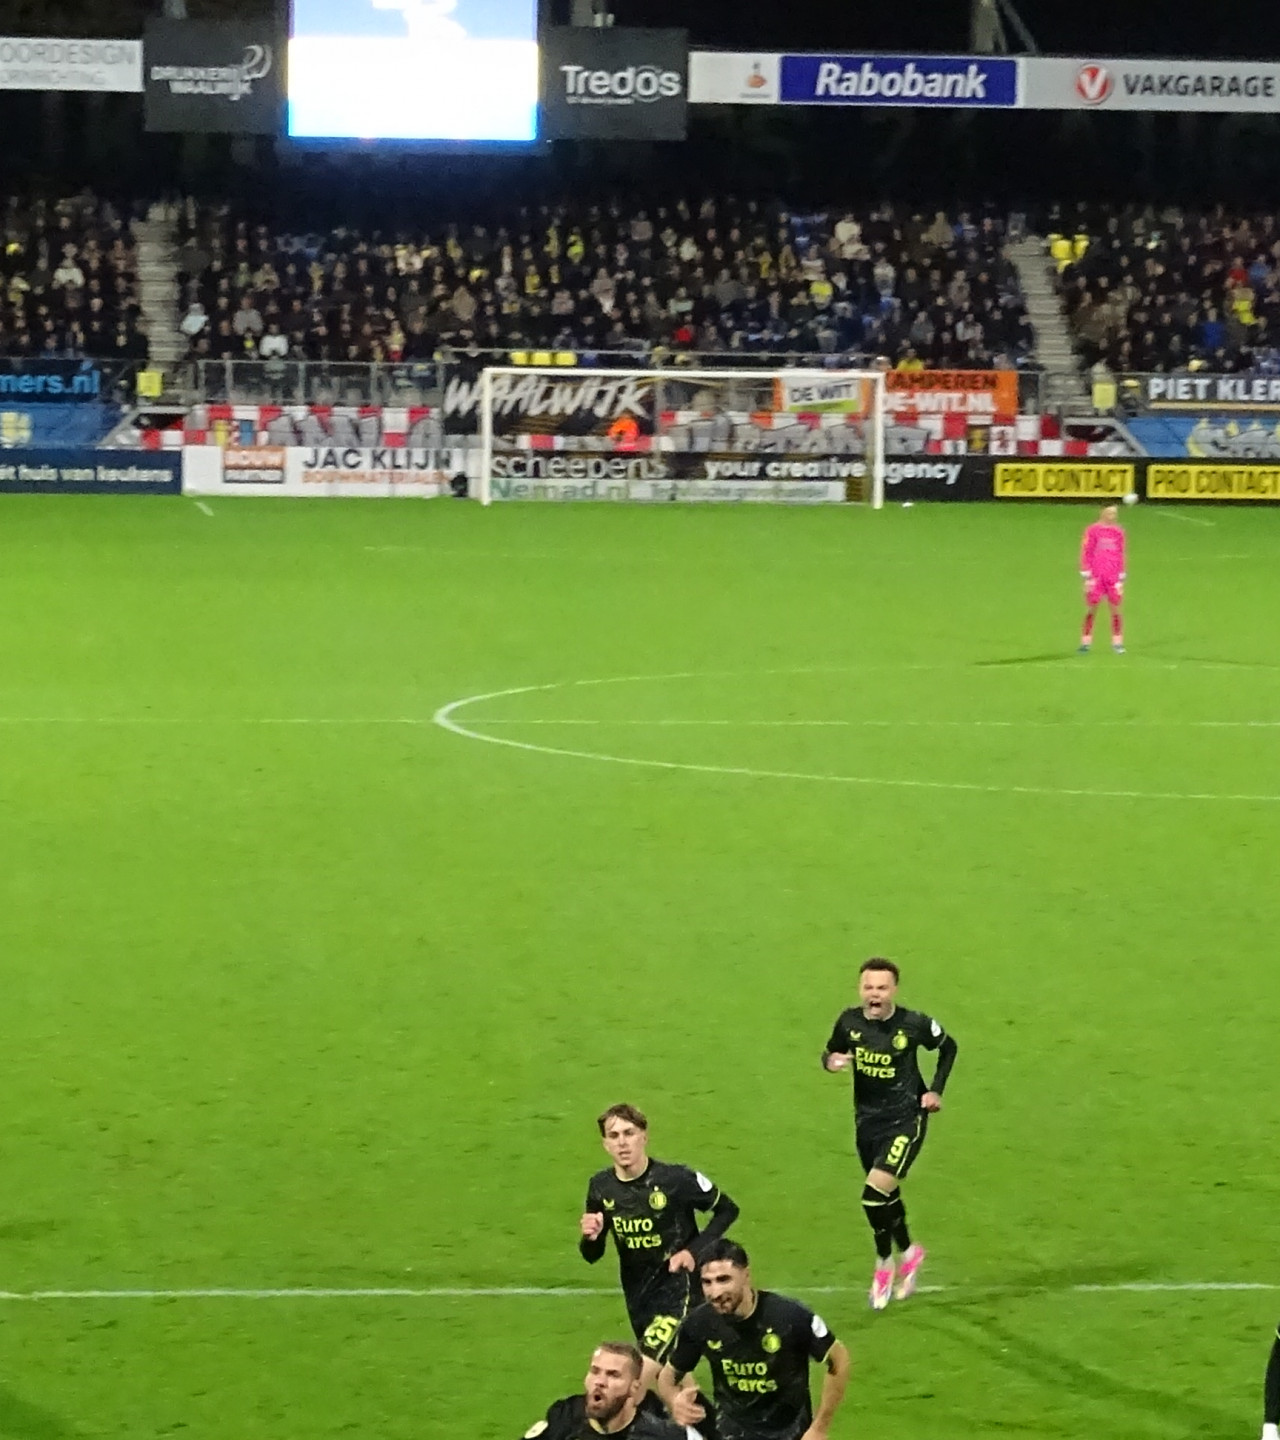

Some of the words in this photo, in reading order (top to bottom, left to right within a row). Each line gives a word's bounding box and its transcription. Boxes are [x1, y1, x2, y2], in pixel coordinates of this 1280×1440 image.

[559, 65, 682, 97] Tredos
[815, 62, 987, 98] Rabobank
[1122, 73, 1276, 97] VAKGARAGE
[1148, 377, 1212, 400] PIET
[302, 448, 363, 470] JAC
[704, 461, 761, 480] your
[765, 456, 867, 479] creative
[883, 461, 964, 486] gency
[1000, 467, 1037, 492] PRO
[1041, 468, 1130, 493] CONTACT
[1153, 469, 1191, 494] PRO
[855, 1046, 892, 1066] Euro
[613, 1216, 654, 1234] Euro
[720, 1358, 768, 1376] Euro
